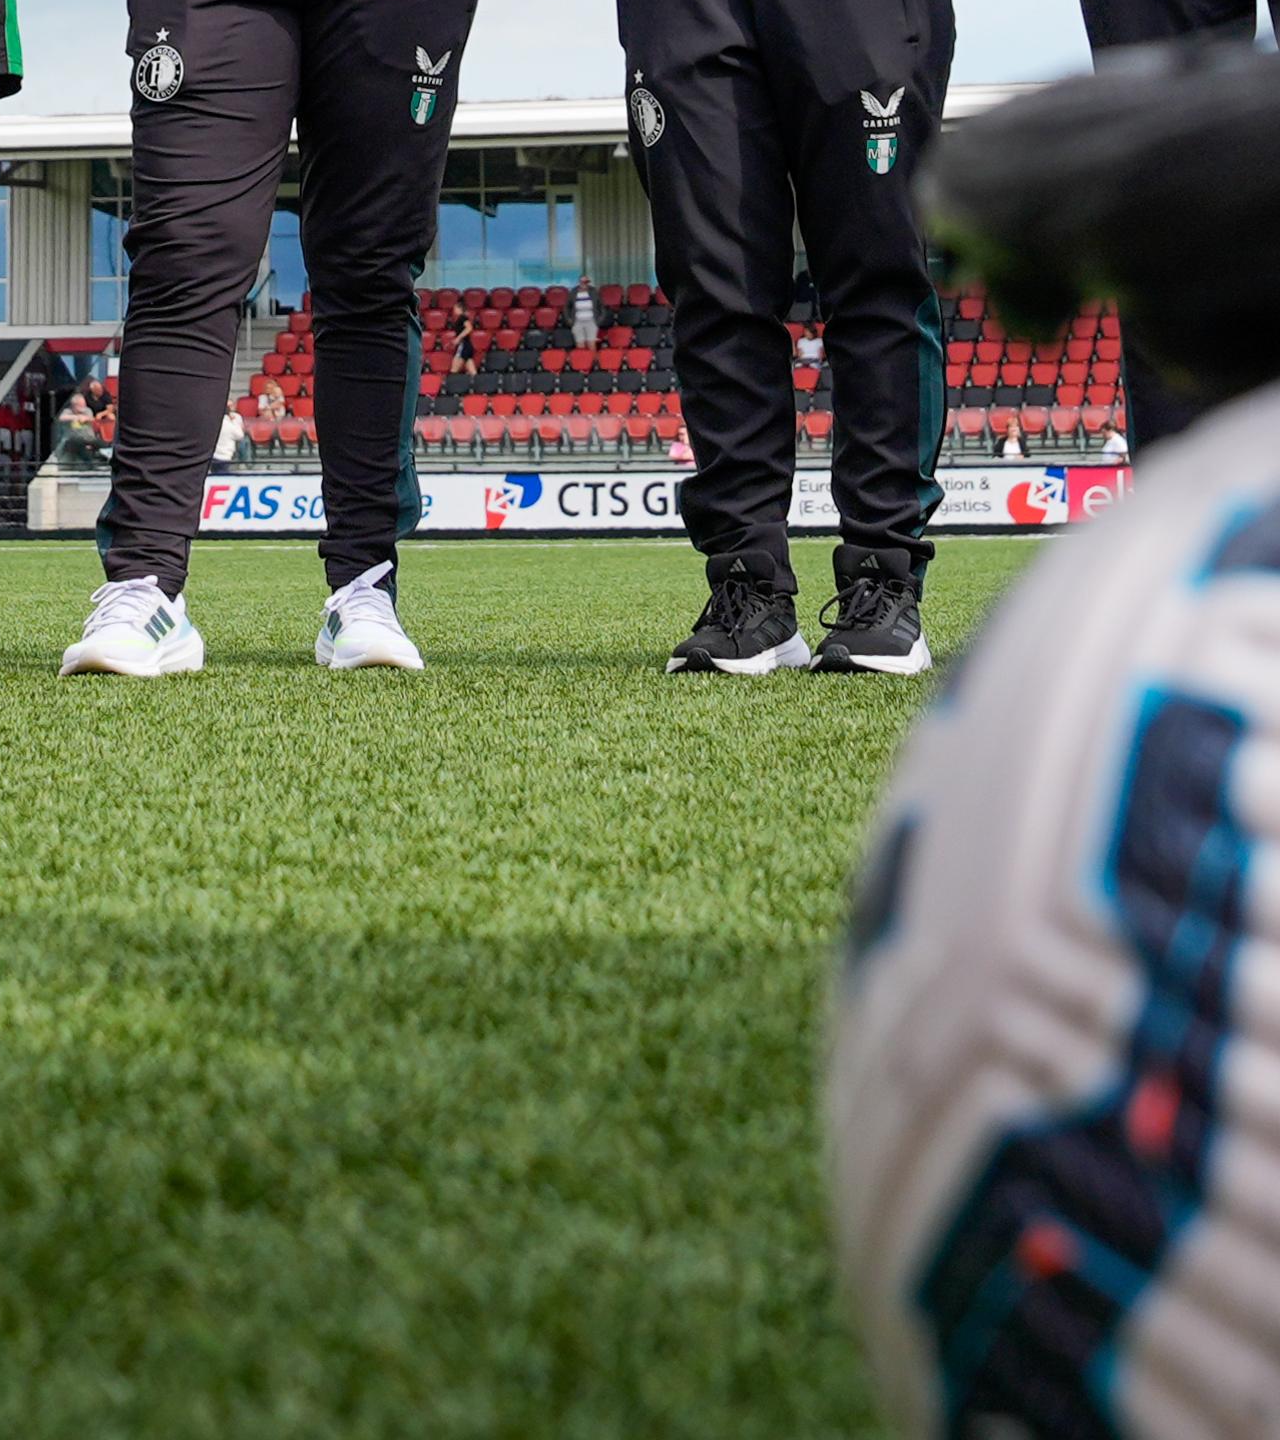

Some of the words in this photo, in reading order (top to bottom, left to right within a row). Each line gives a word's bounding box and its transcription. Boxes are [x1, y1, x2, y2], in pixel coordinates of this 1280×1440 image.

[940, 477, 974, 490] tion
[202, 485, 283, 520] FAS
[558, 482, 629, 517] CTS
[939, 499, 992, 516] gistics
